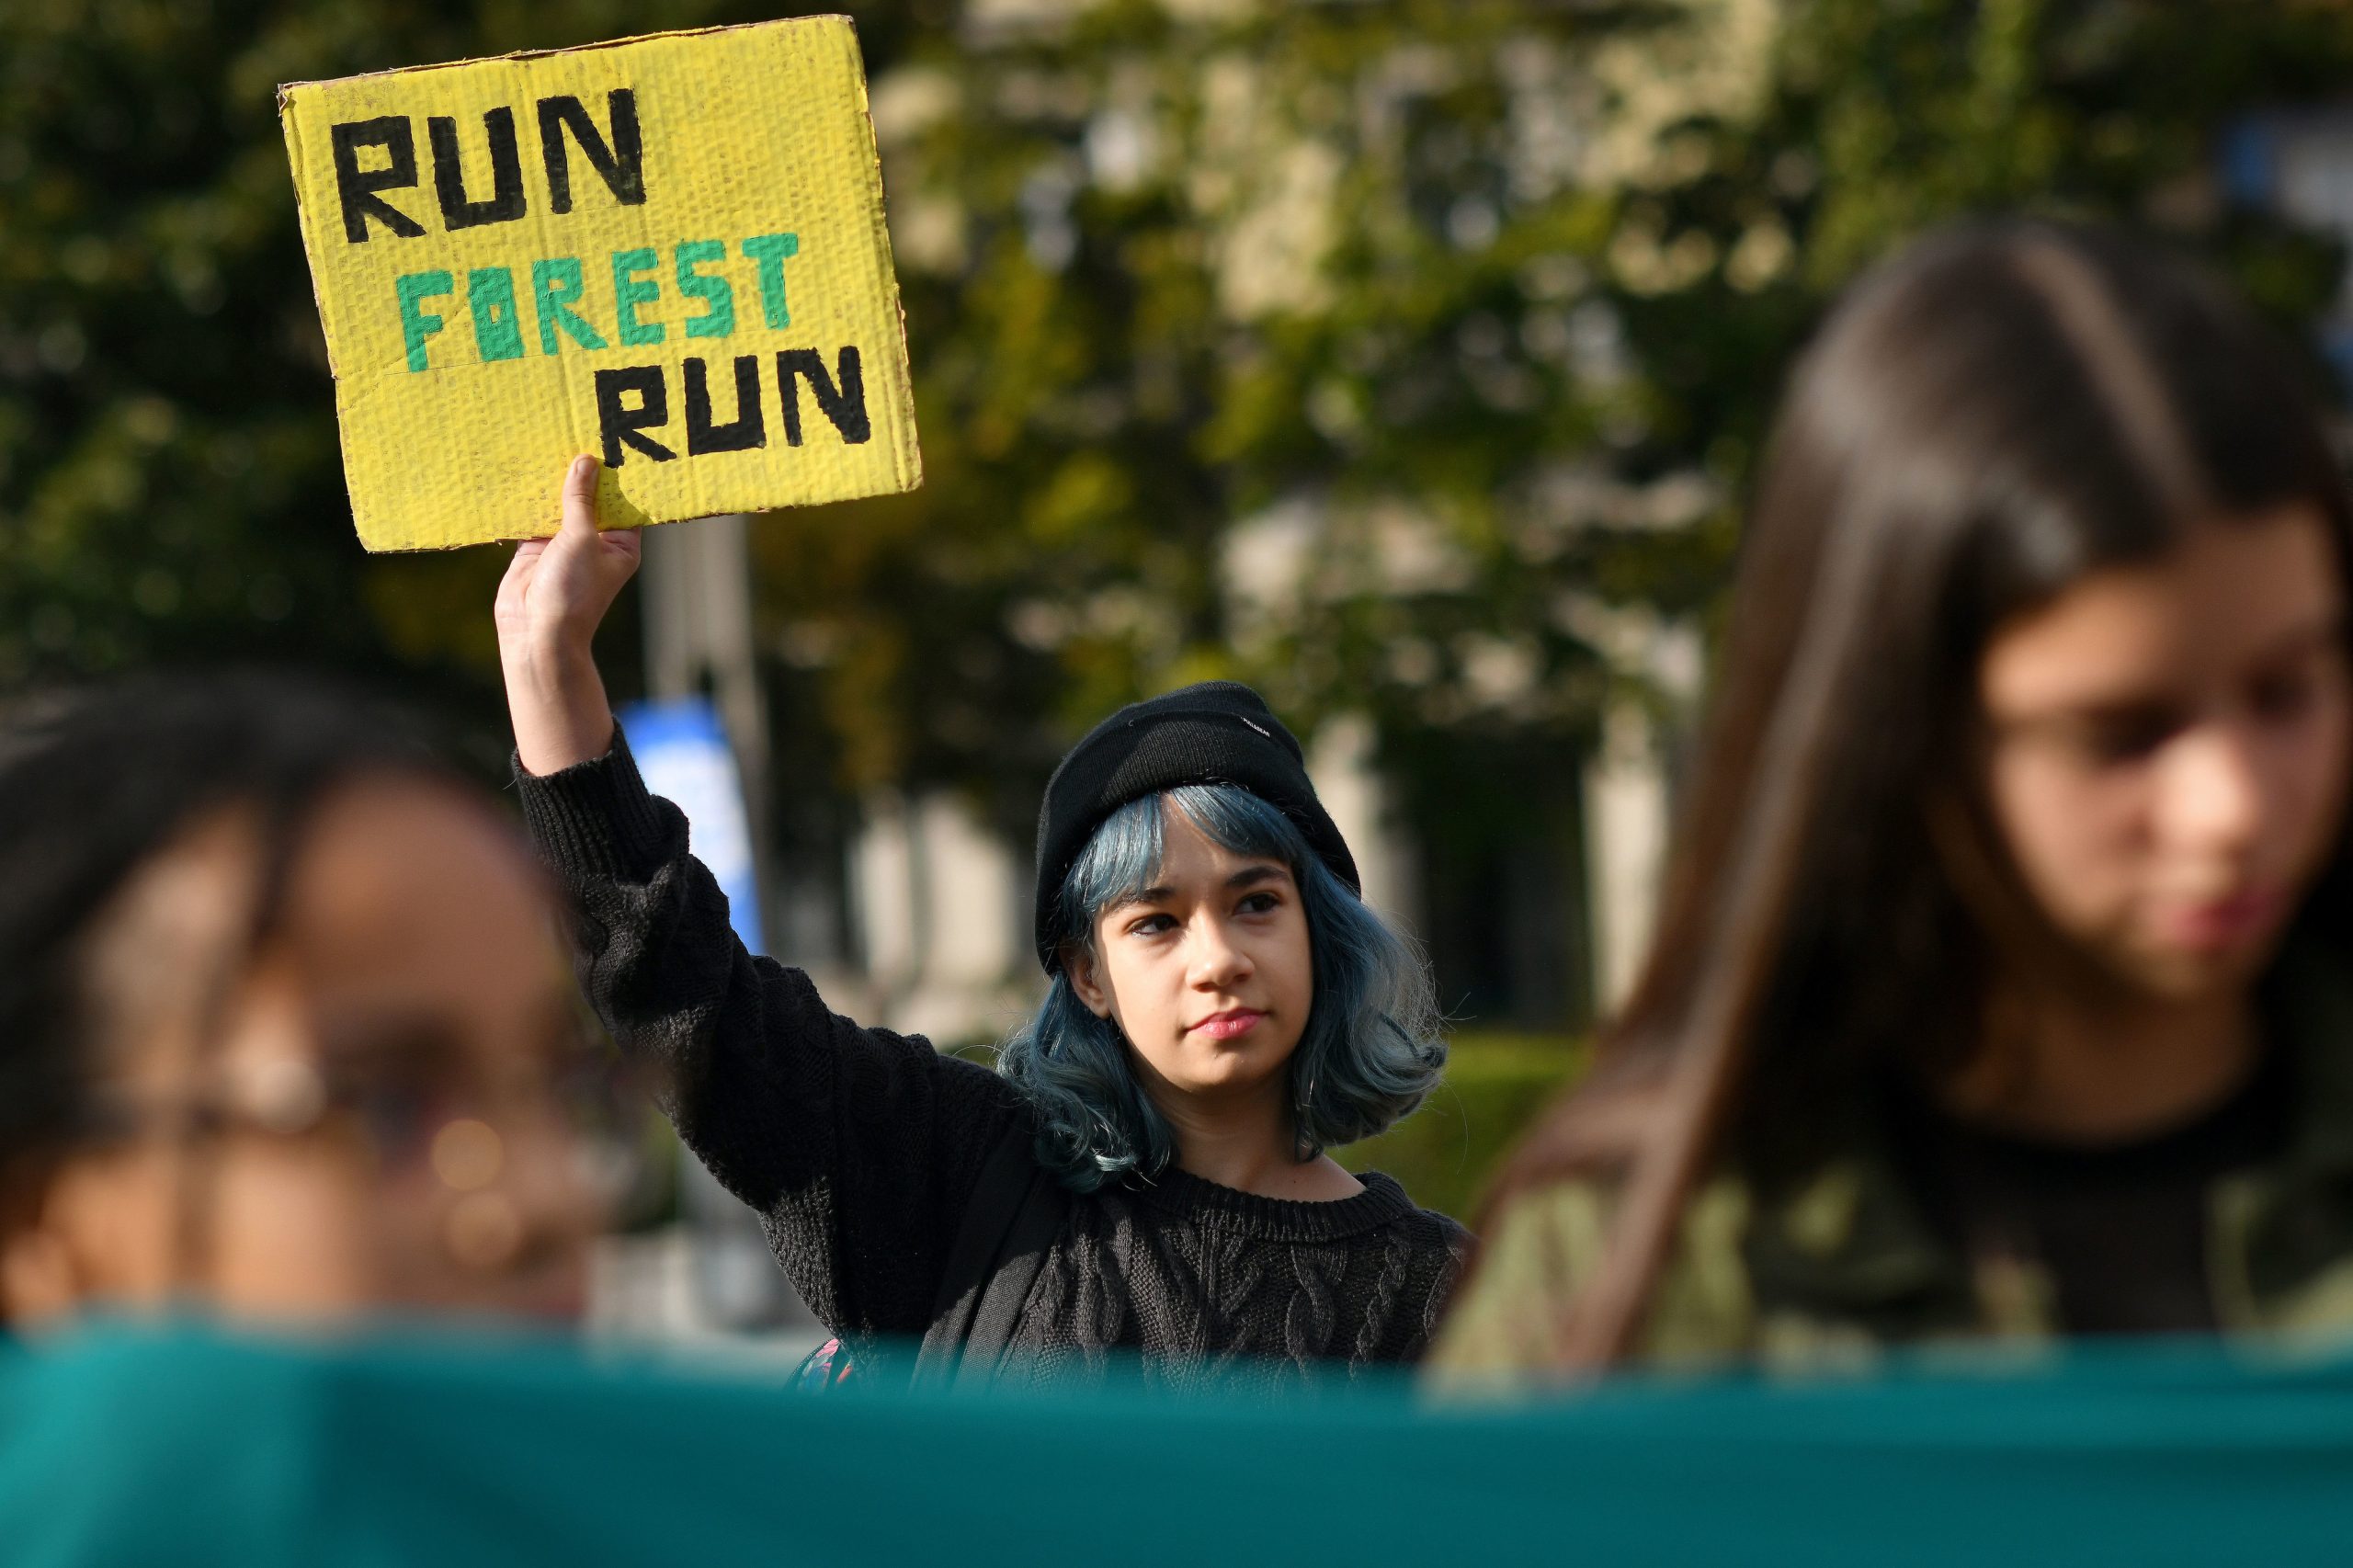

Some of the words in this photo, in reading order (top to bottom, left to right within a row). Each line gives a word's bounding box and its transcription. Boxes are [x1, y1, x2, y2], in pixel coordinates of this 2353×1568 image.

[331, 88, 646, 243] RUN
[397, 233, 799, 372] FOREST
[595, 346, 871, 469] RUN
